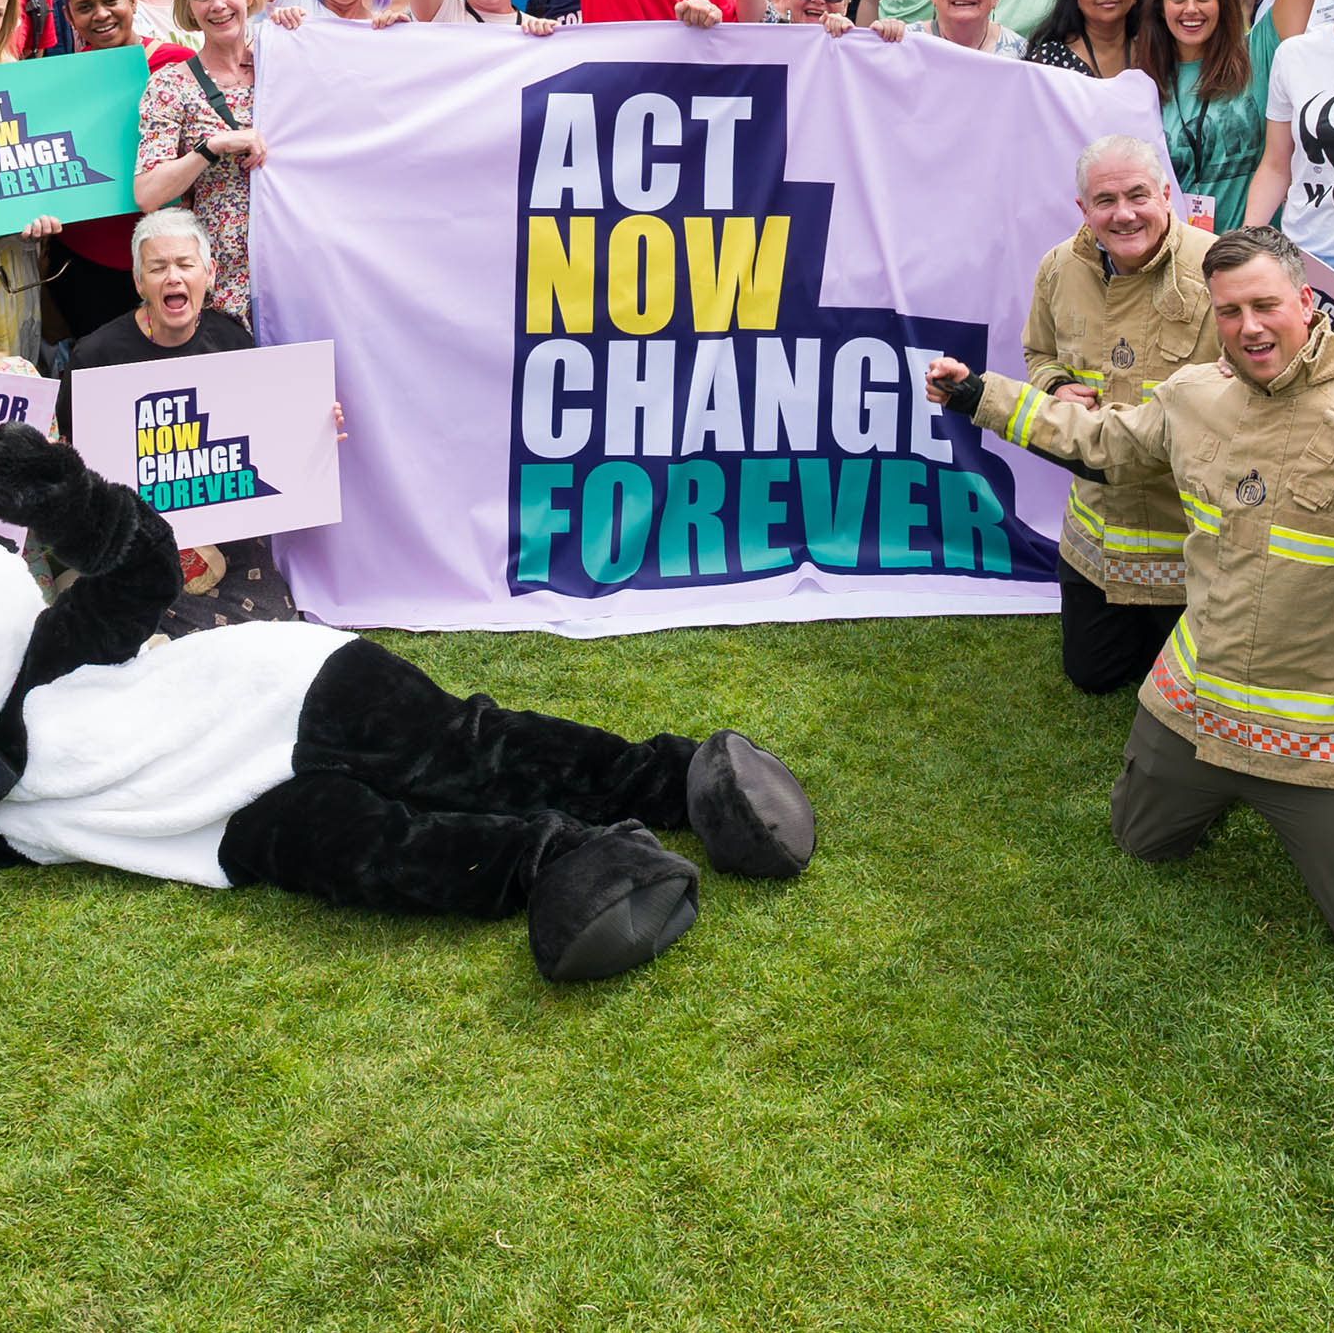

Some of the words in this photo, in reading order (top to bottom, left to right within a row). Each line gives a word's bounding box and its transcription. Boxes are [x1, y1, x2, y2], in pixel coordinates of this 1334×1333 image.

[530, 93, 752, 212] ACT
[527, 216, 790, 335] NOW
[522, 337, 953, 463] CHANGE
[517, 457, 1011, 584] FOREVER
[1243, 485, 1259, 500] FBU
